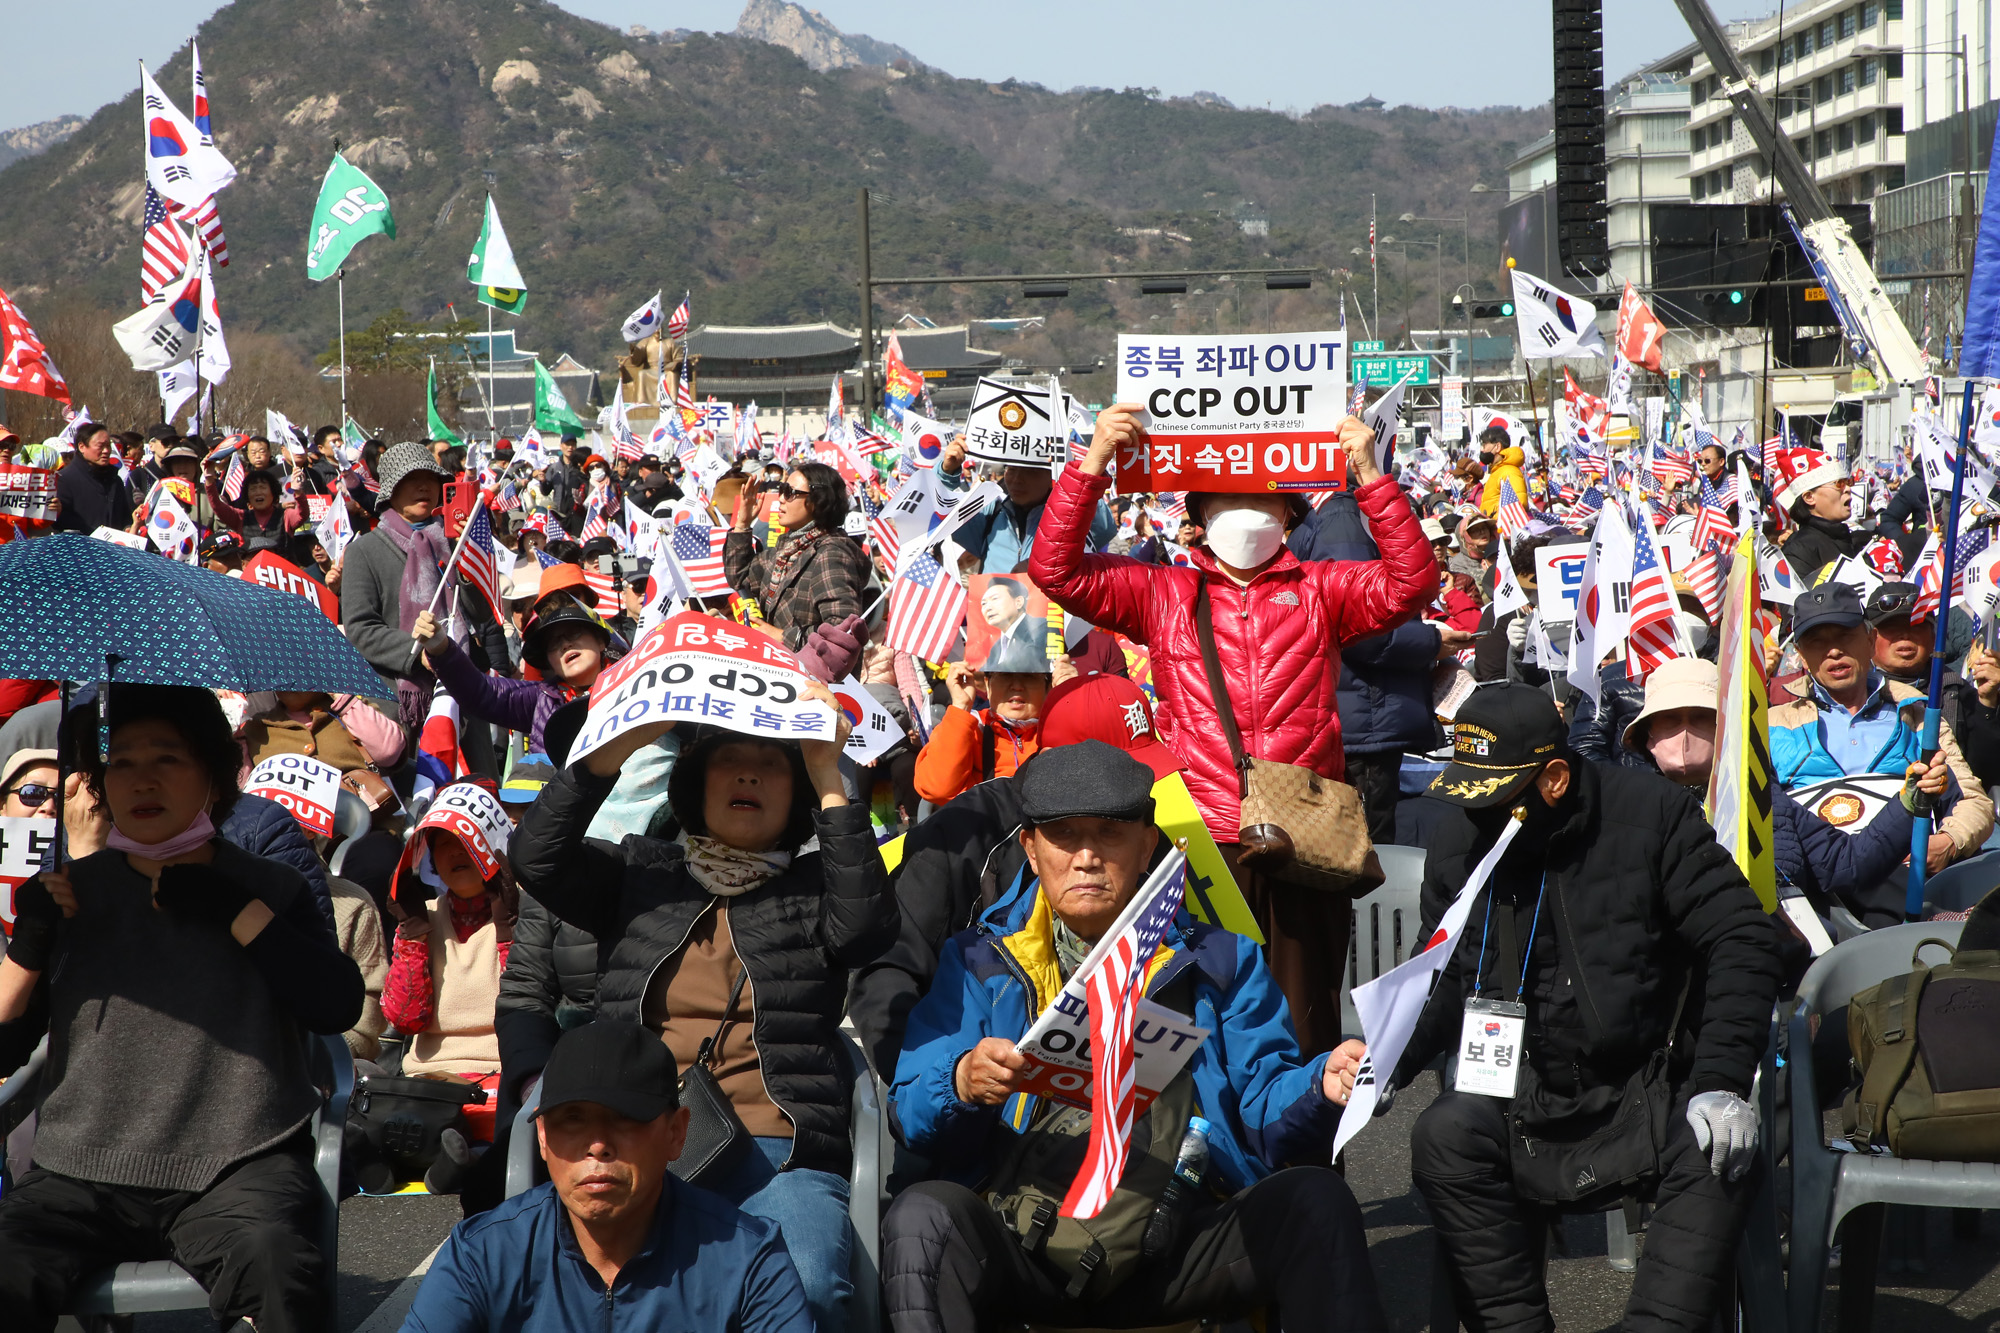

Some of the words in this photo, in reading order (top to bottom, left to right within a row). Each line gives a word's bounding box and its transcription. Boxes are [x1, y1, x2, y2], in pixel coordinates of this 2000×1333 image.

[1124, 346, 1185, 378] 종북
[1195, 344, 1260, 378] 좌파
[1264, 342, 1342, 373] OUT
[1148, 387, 1222, 418] CCP
[1232, 384, 1313, 417] OUT
[971, 426, 1051, 458] 국회해산
[1153, 423, 1189, 432] (Chinese
[1190, 422, 1238, 431] Communist
[1239, 422, 1261, 431] Party
[1262, 420, 1305, 430] 중국공산당)
[1122, 442, 1255, 476] 거짓·속임
[1263, 442, 1342, 474] OUT
[674, 622, 800, 670] 짓·속임
[690, 654, 750, 669] Communist
[592, 634, 665, 700] OUT
[751, 664, 795, 678] (Chinese
[606, 663, 694, 714] OUT
[708, 668, 798, 704] CCP
[657, 691, 737, 720] 좌파
[750, 704, 827, 733] 종북
[572, 699, 651, 758] OUT
[1467, 723, 1480, 735] WAR
[1480, 728, 1498, 743] HERO
[254, 771, 316, 792] OUT
[280, 757, 338, 783] OUT
[273, 794, 332, 826] OUT
[446, 797, 498, 833] OUT
[478, 794, 514, 841] OUT
[455, 819, 499, 866] OUT
[1053, 990, 1089, 1027] 파
[1132, 1019, 1199, 1053] UT
[1037, 1051, 1064, 1063] Party
